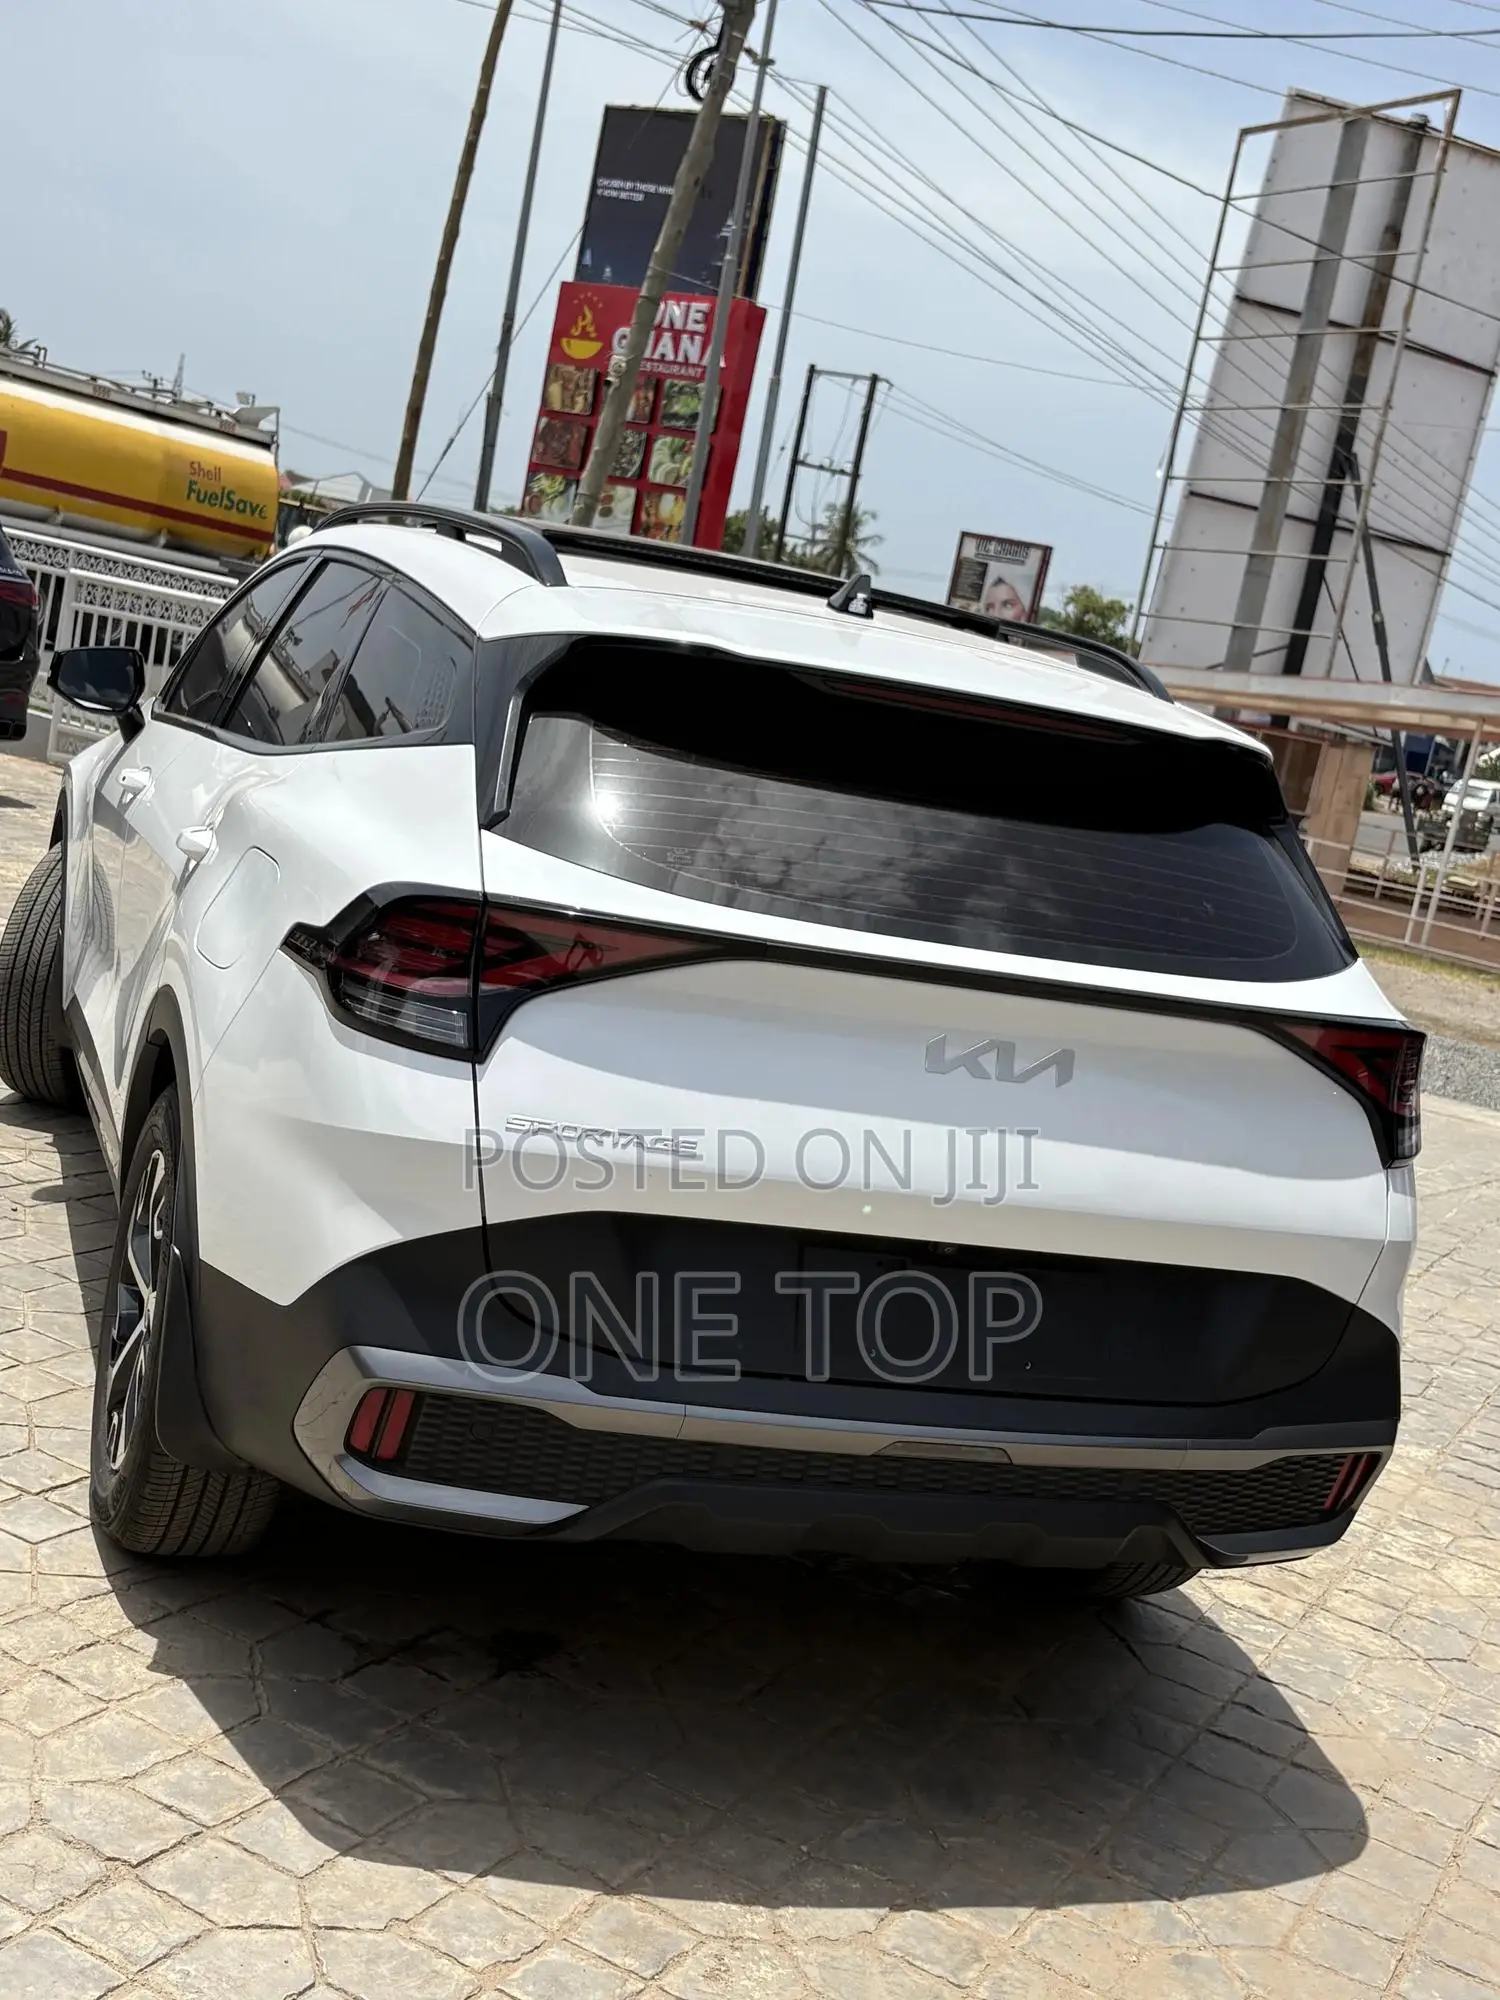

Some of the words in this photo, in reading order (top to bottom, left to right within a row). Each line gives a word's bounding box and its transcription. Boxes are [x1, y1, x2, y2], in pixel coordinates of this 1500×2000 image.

[640, 361, 704, 378] ESTAURANT
[189, 461, 222, 482] Shell
[186, 479, 268, 519] FuelSave
[504, 1113, 699, 1159] SPORTAGE
